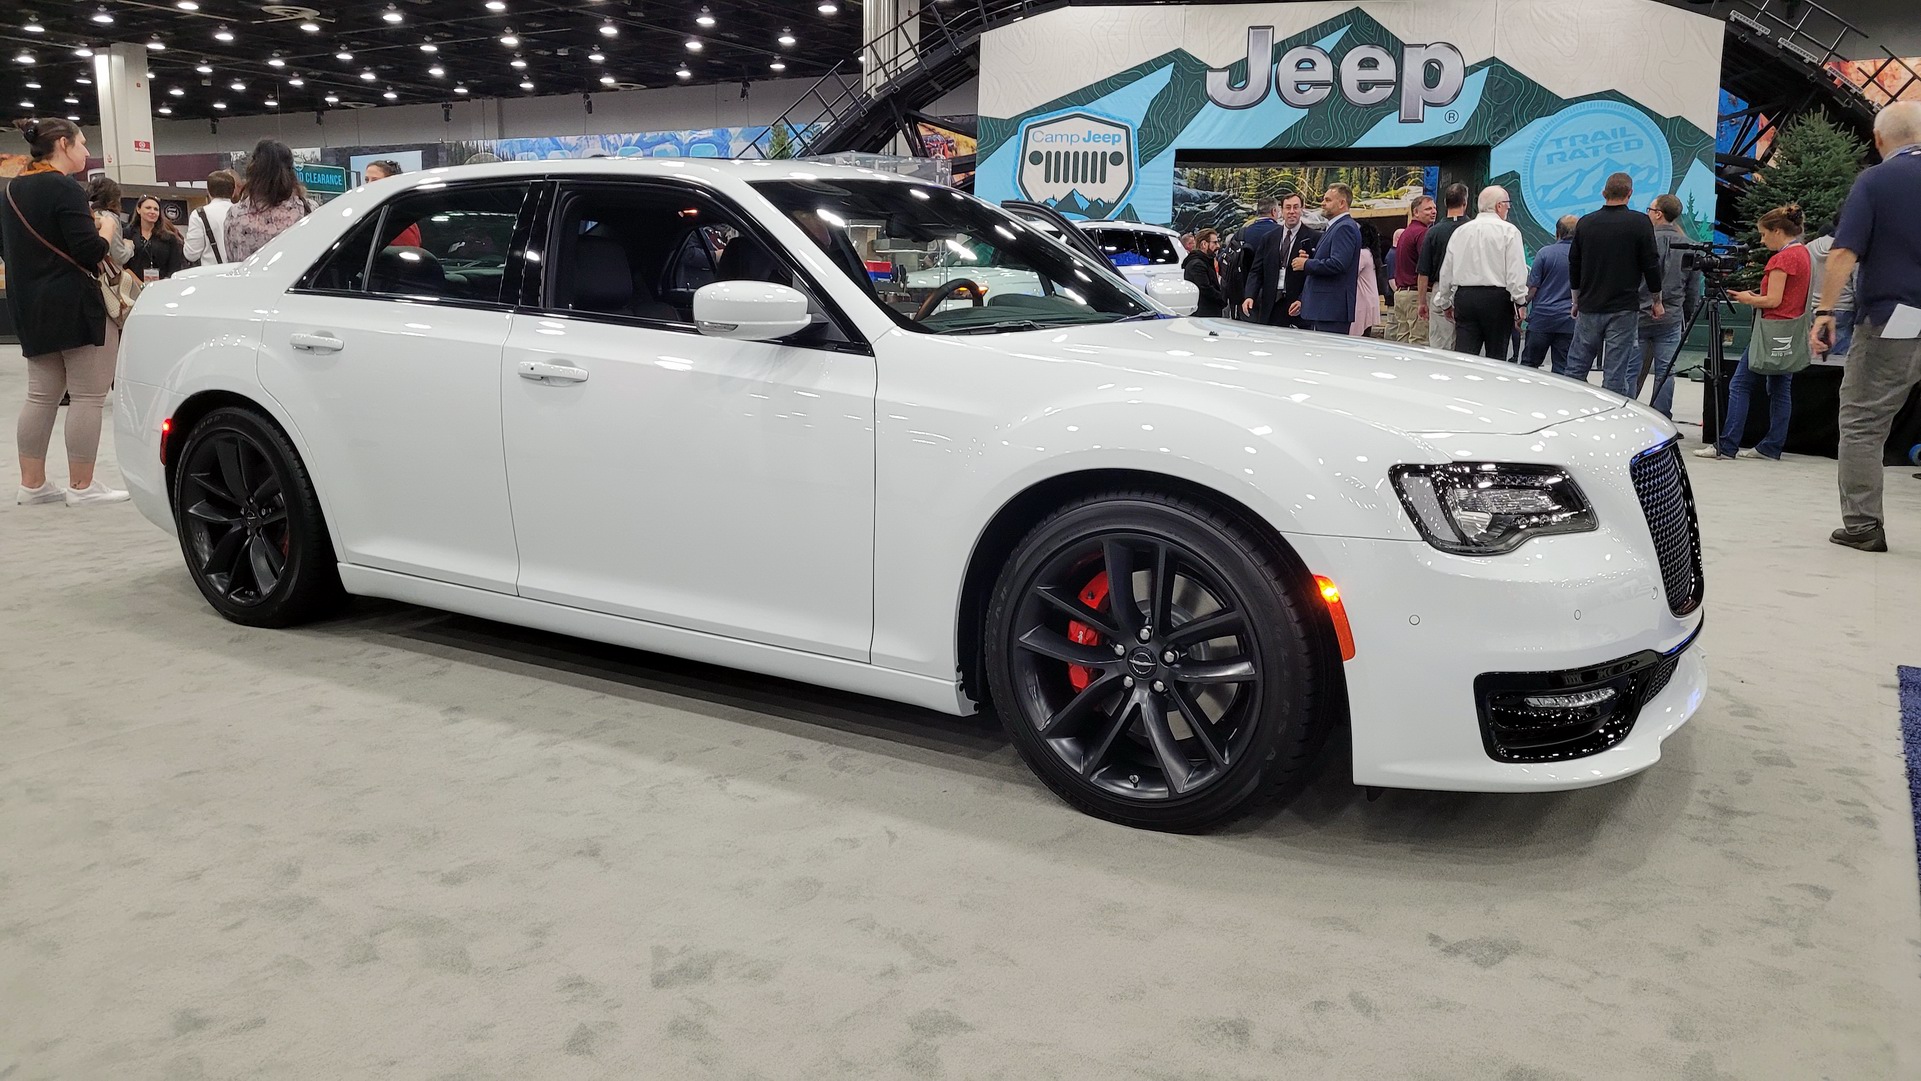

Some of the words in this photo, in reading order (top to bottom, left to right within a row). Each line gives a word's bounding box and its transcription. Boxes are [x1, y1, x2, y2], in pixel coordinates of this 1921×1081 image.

[1205, 25, 1465, 123] Jeep
[1031, 130, 1080, 146] Camp
[1082, 130, 1122, 146] Jeep
[1550, 126, 1637, 150] TRAIL
[1545, 138, 1644, 165] RATED
[305, 171, 343, 186] CLEARANCE
